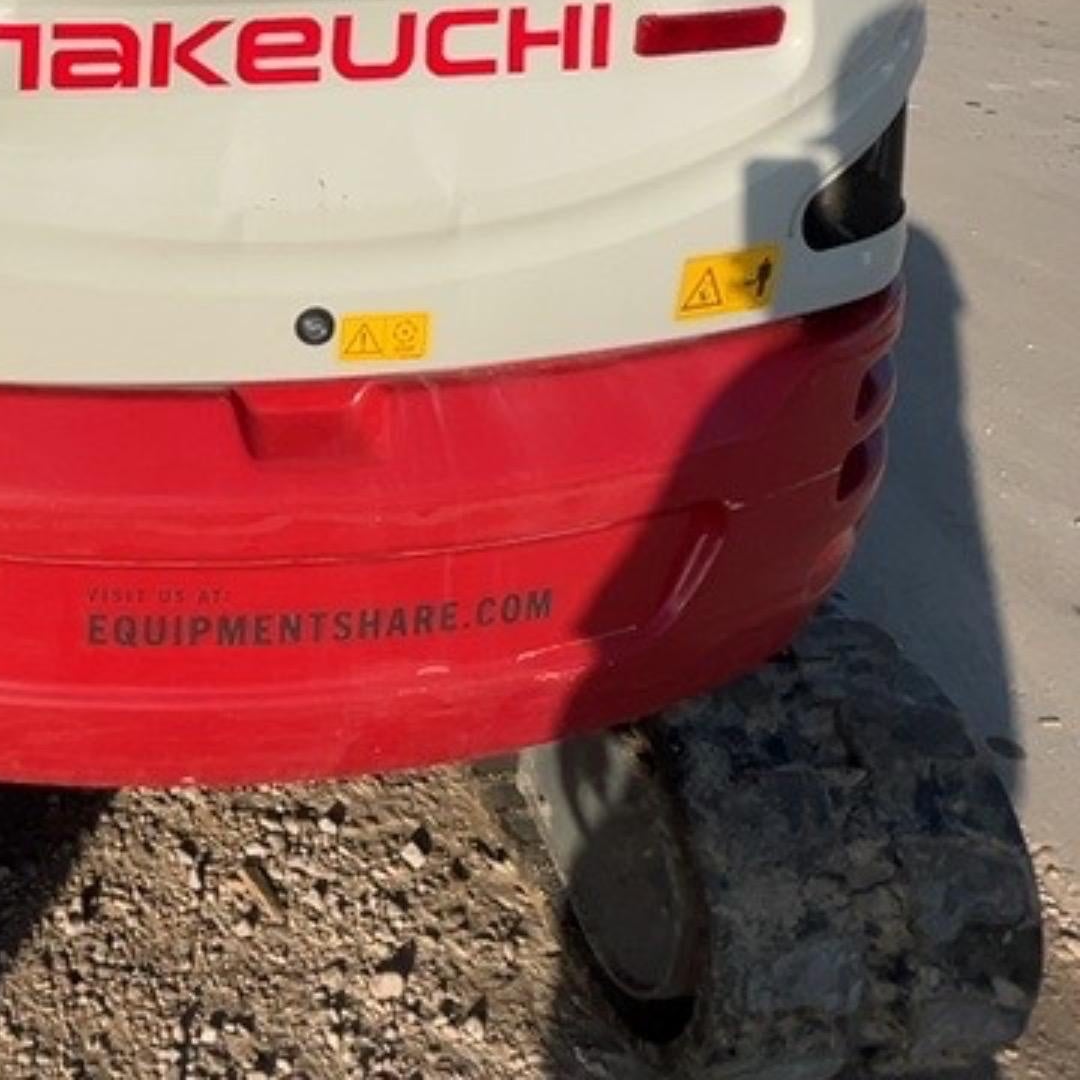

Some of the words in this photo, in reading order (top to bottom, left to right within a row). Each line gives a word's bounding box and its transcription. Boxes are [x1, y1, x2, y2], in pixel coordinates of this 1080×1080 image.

[87, 587, 145, 604] VISIT
[158, 588, 185, 604] US
[87, 589, 554, 646] EQUIPMENTSHARE.COM
